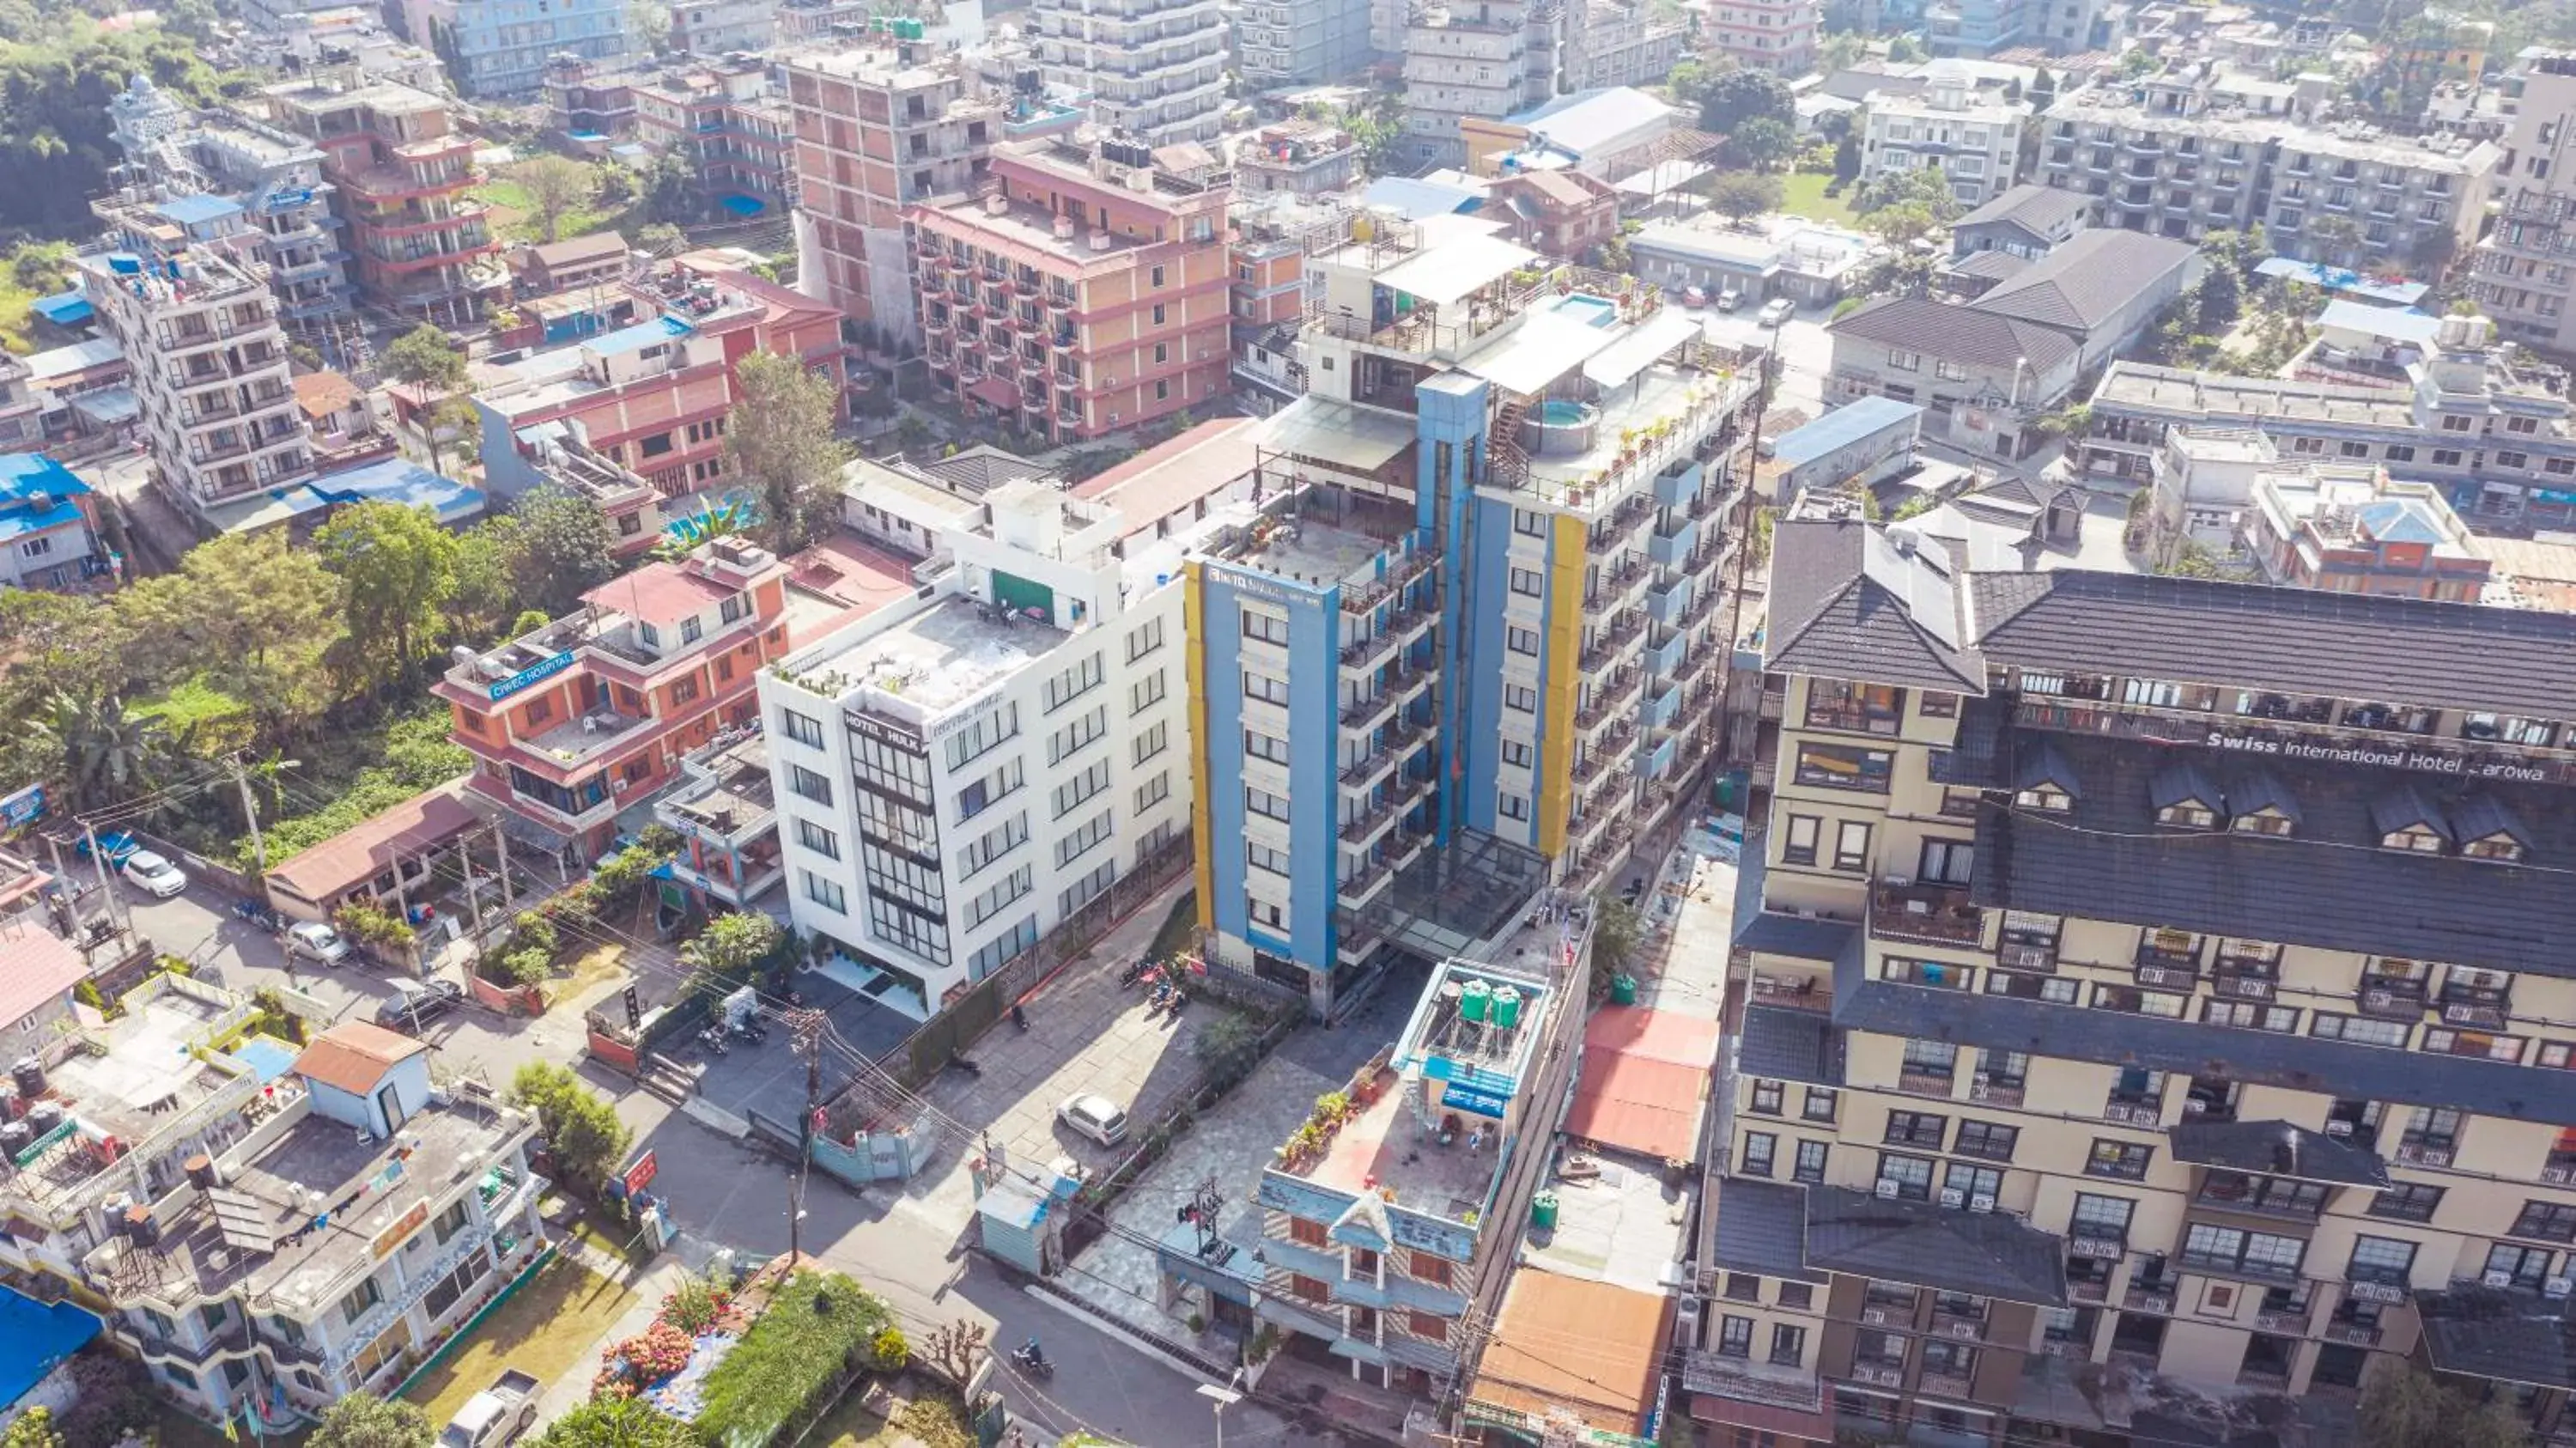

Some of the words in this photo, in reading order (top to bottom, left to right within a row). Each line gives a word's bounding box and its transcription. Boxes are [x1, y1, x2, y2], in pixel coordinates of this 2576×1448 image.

[493, 675, 525, 697] CIWEC
[526, 654, 573, 682] HOSPITAL
[846, 714, 882, 736] HOTEL
[886, 729, 919, 751] HULK
[2207, 732, 2278, 753] Swiss
[2285, 741, 2403, 766] International
[2409, 752, 2462, 773] Hotel
